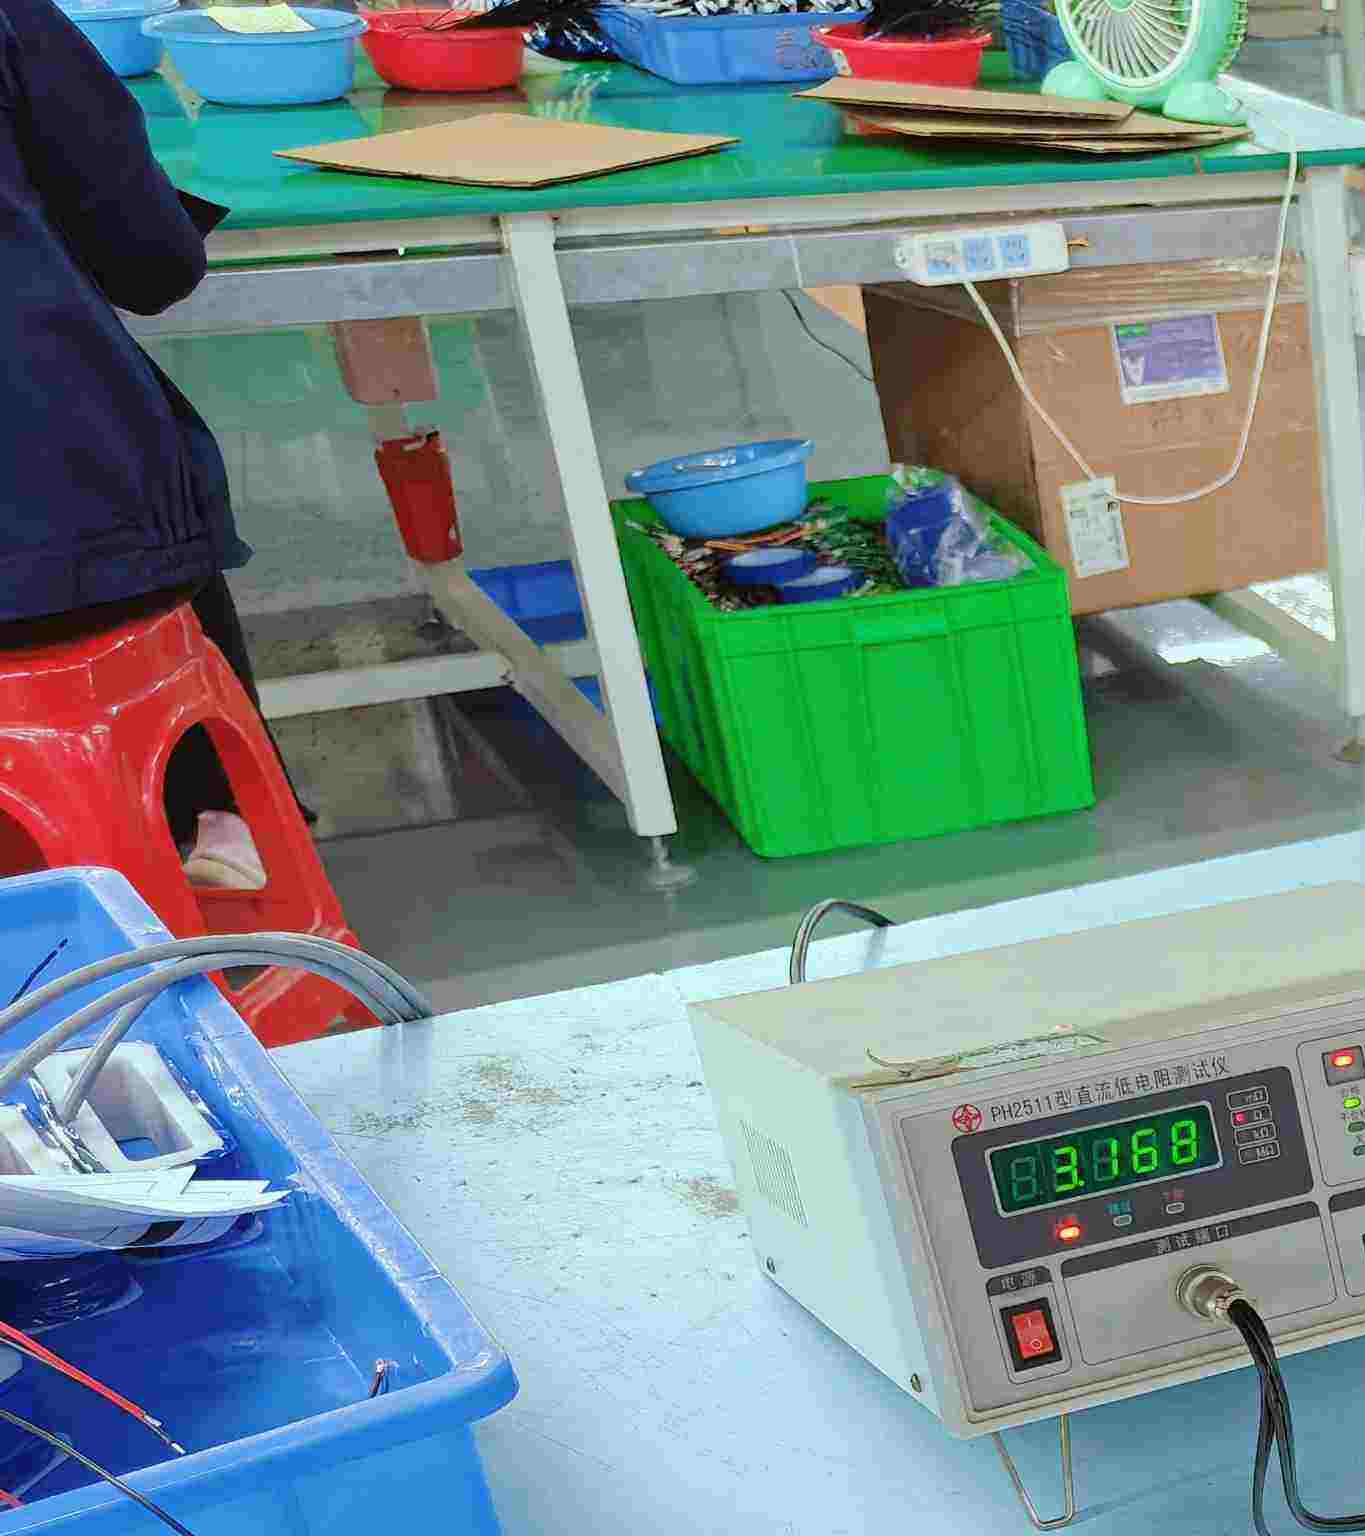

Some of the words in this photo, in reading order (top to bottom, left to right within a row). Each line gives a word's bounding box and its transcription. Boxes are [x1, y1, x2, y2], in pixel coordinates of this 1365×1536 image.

[990, 1056, 1230, 1122] PH2511型直流低电阻测试仪
[1055, 1119, 1198, 1192] 3.168
[1156, 1223, 1232, 1255] 测试端口
